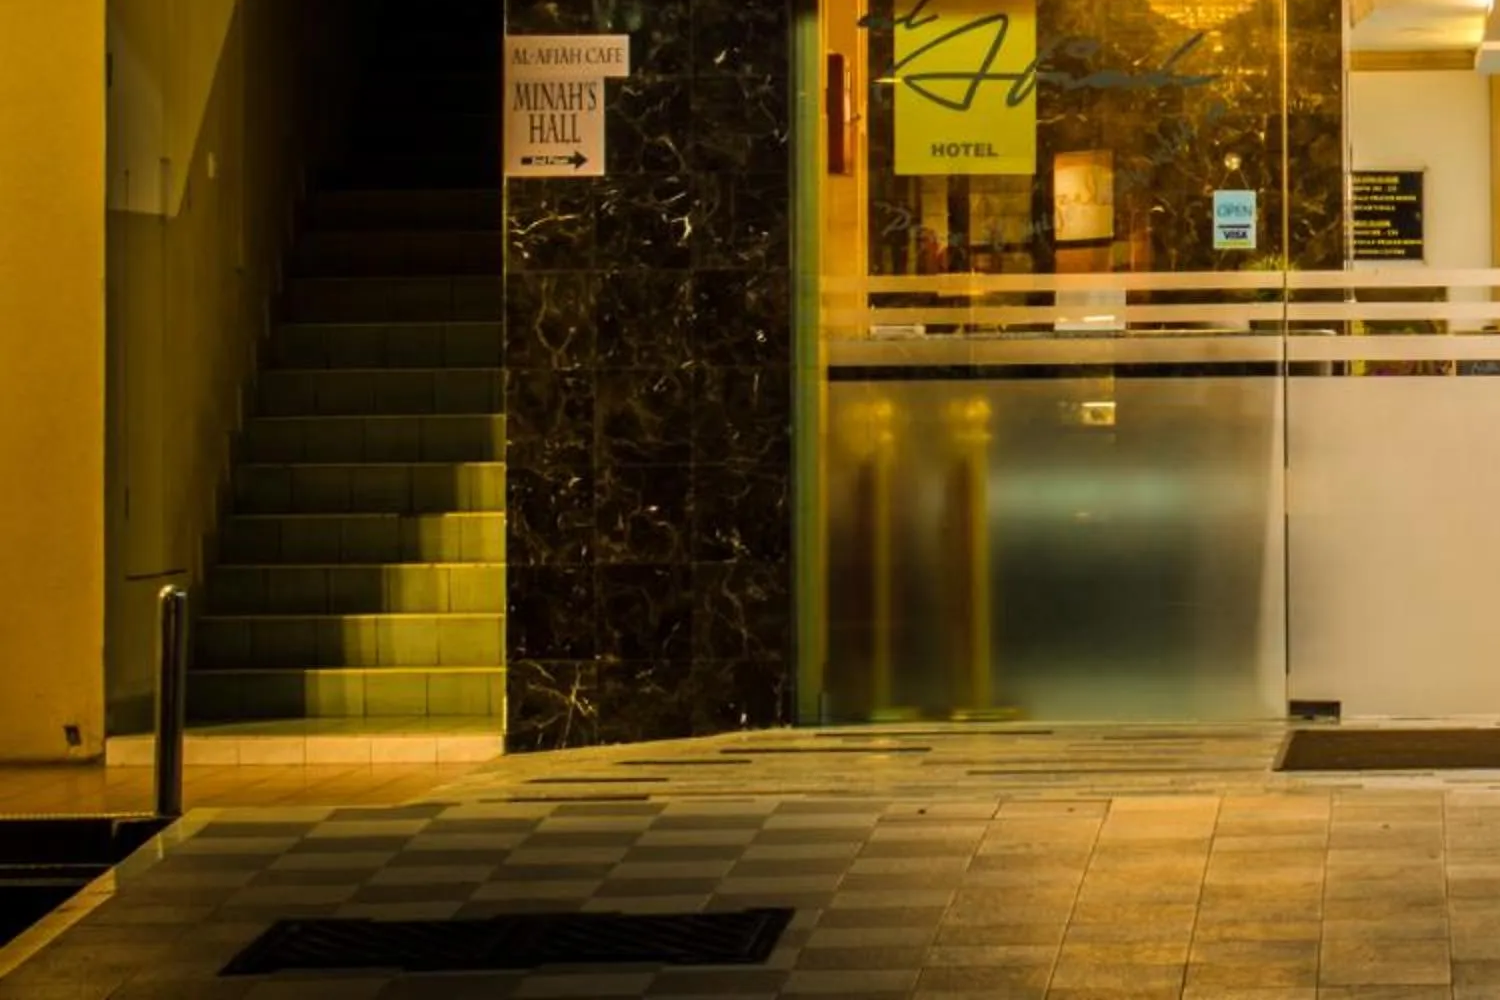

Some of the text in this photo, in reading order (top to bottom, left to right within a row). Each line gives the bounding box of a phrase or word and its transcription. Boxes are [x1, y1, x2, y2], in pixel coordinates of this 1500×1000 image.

[512, 47, 624, 65] AL-AFIAH CAFE
[513, 81, 598, 112] MINAH'S
[529, 113, 583, 144] HALL
[931, 143, 999, 158] HOTEL
[1217, 203, 1253, 218] OPEN
[1223, 230, 1248, 241] VISA
